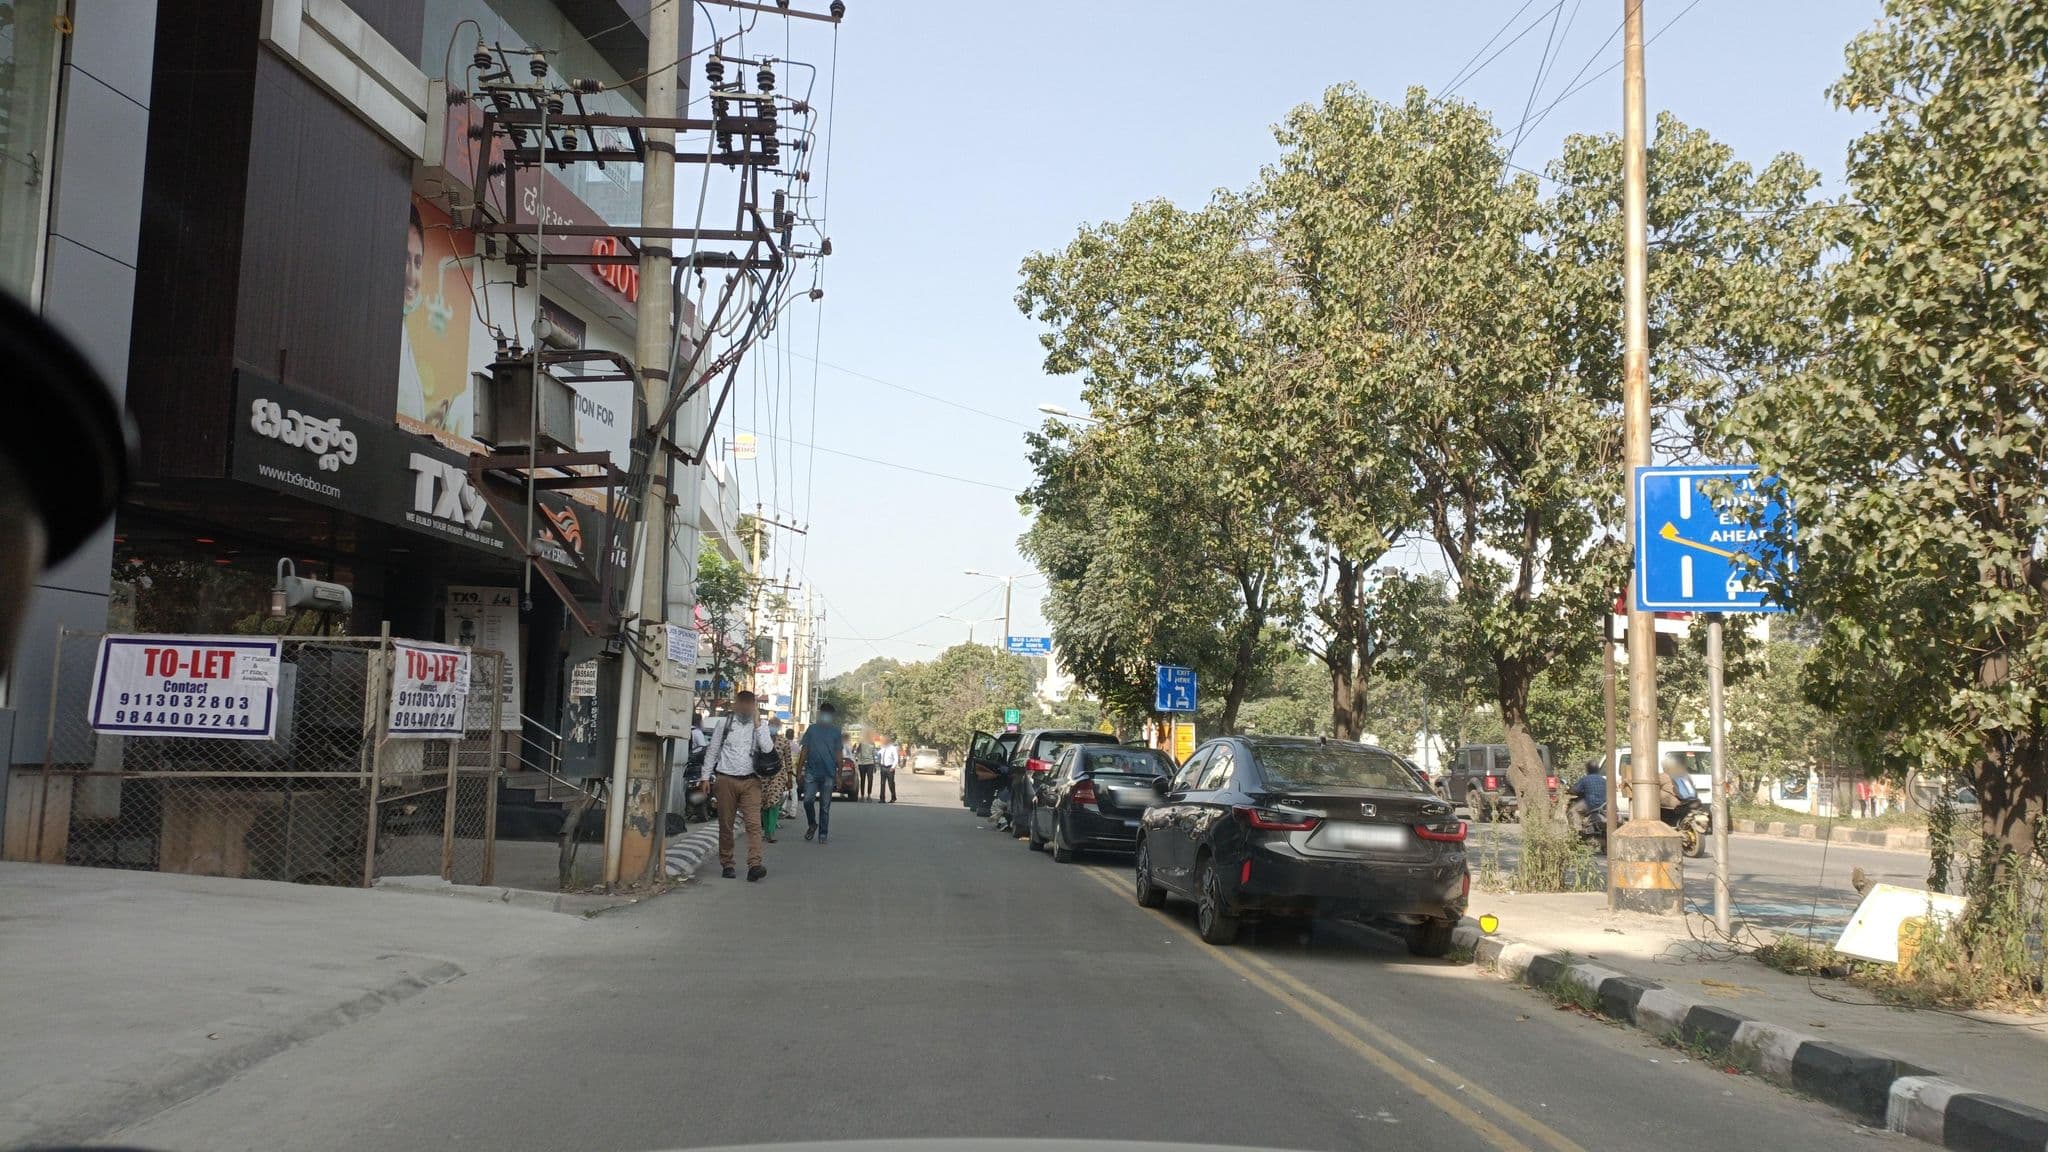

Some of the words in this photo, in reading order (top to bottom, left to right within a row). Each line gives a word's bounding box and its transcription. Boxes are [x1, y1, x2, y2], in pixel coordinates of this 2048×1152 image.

[597, 404, 614, 428] FOR
[258, 463, 341, 499] www.tx9robo.com
[406, 511, 416, 522] WE
[415, 514, 432, 527] BUILD
[144, 648, 236, 680] TO-LET
[405, 650, 458, 683] TO-LET
[574, 670, 596, 678] MASSAGE
[163, 680, 208, 694] Contact
[119, 692, 249, 710] 9113032803
[115, 710, 249, 728] 9844002244
